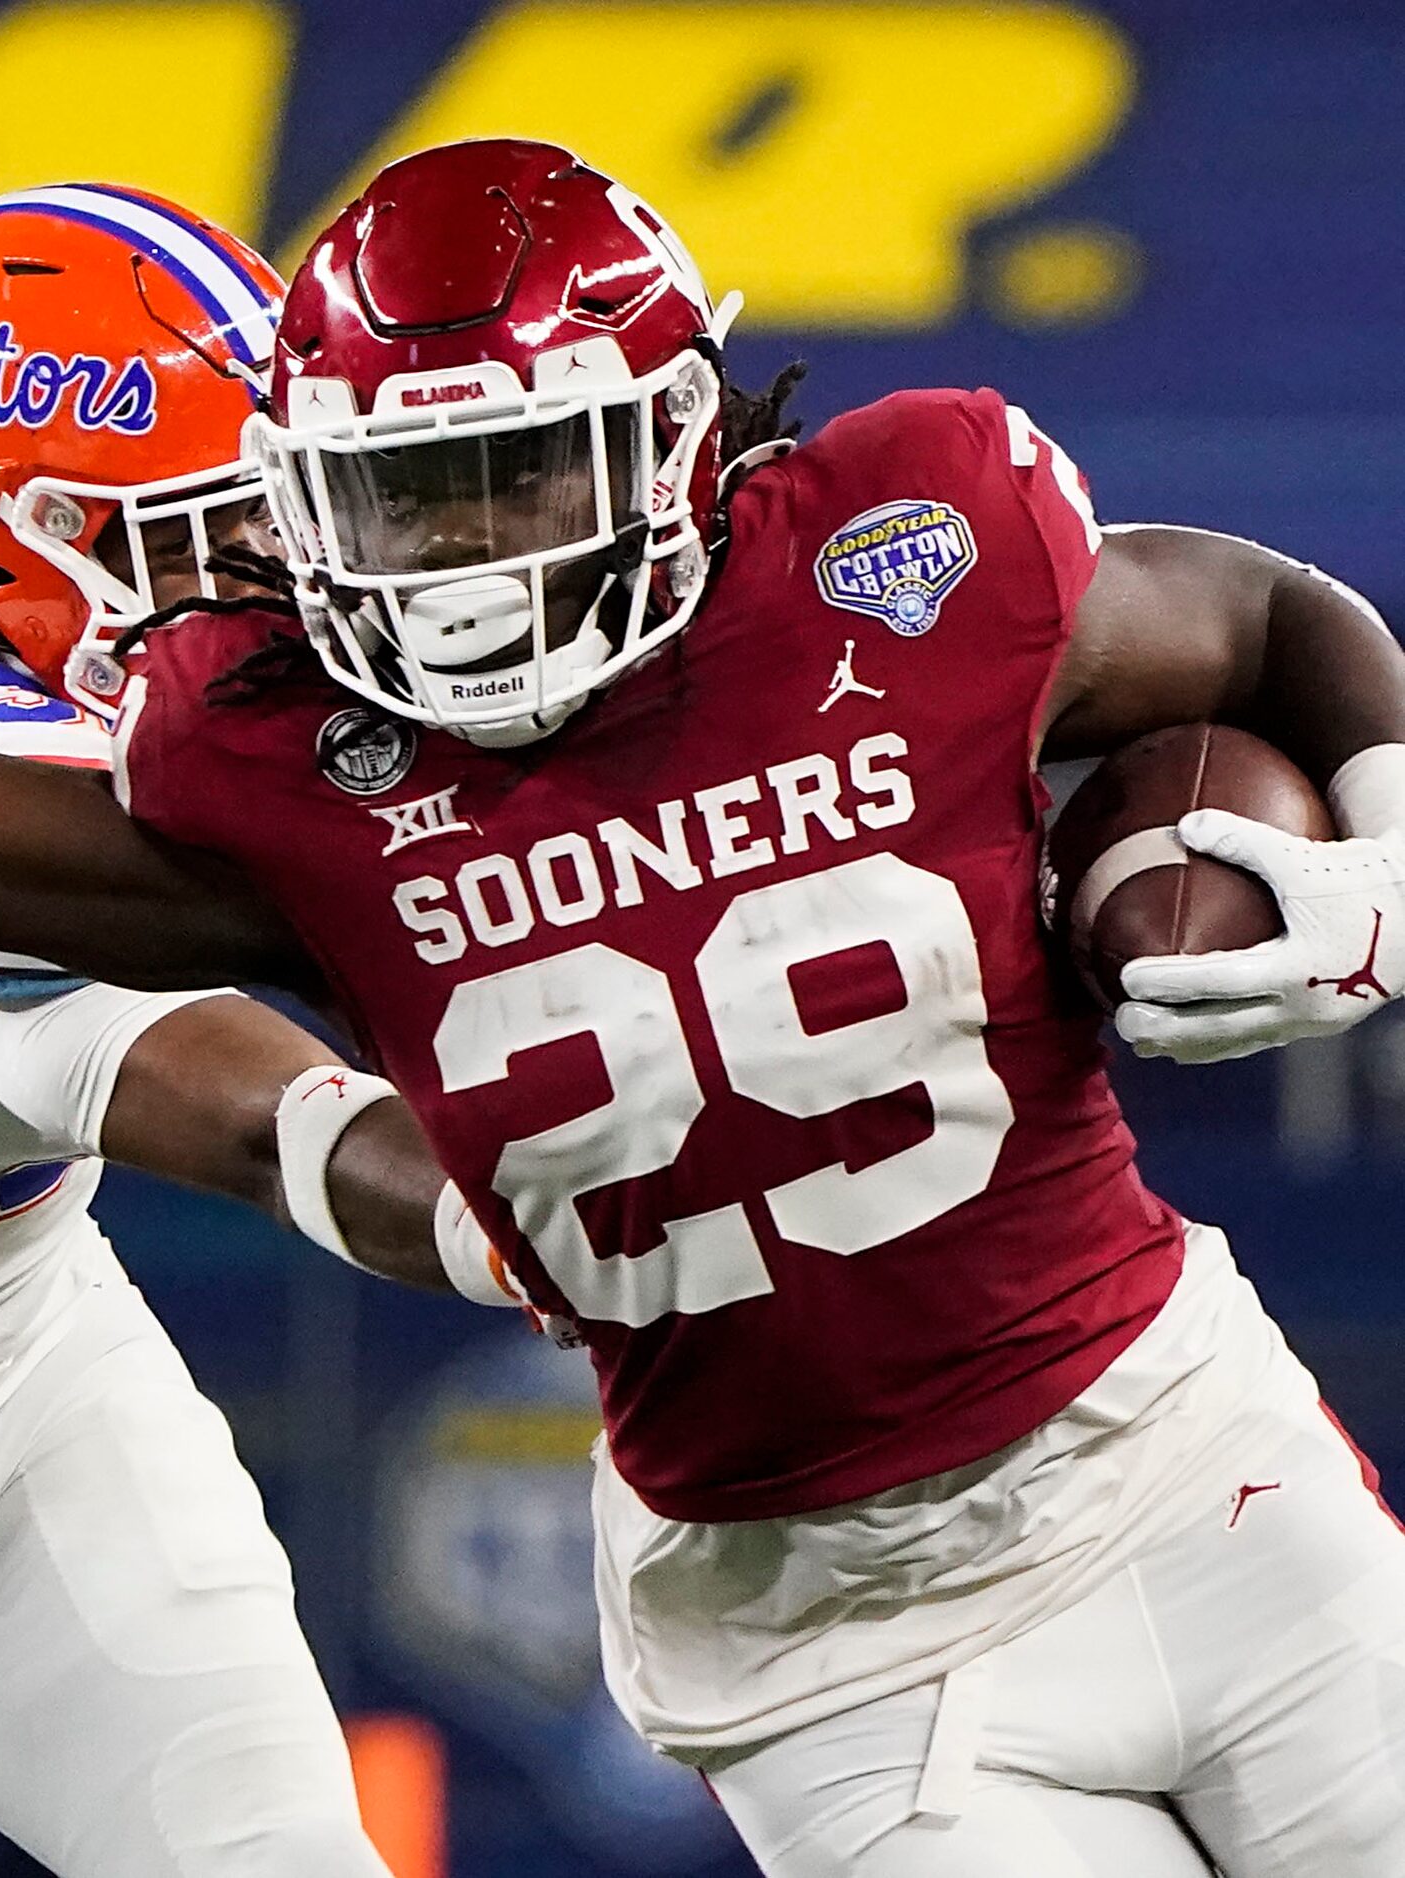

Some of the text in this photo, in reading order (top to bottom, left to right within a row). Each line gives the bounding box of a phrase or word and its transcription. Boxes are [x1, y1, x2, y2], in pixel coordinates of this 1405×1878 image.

[825, 509, 948, 558] GOODYEAR
[830, 523, 963, 595] COTTON
[858, 556, 944, 596] BOWL
[451, 676, 525, 700] Riddell
[392, 732, 916, 966] SOONERS
[432, 851, 1016, 1329] 29
